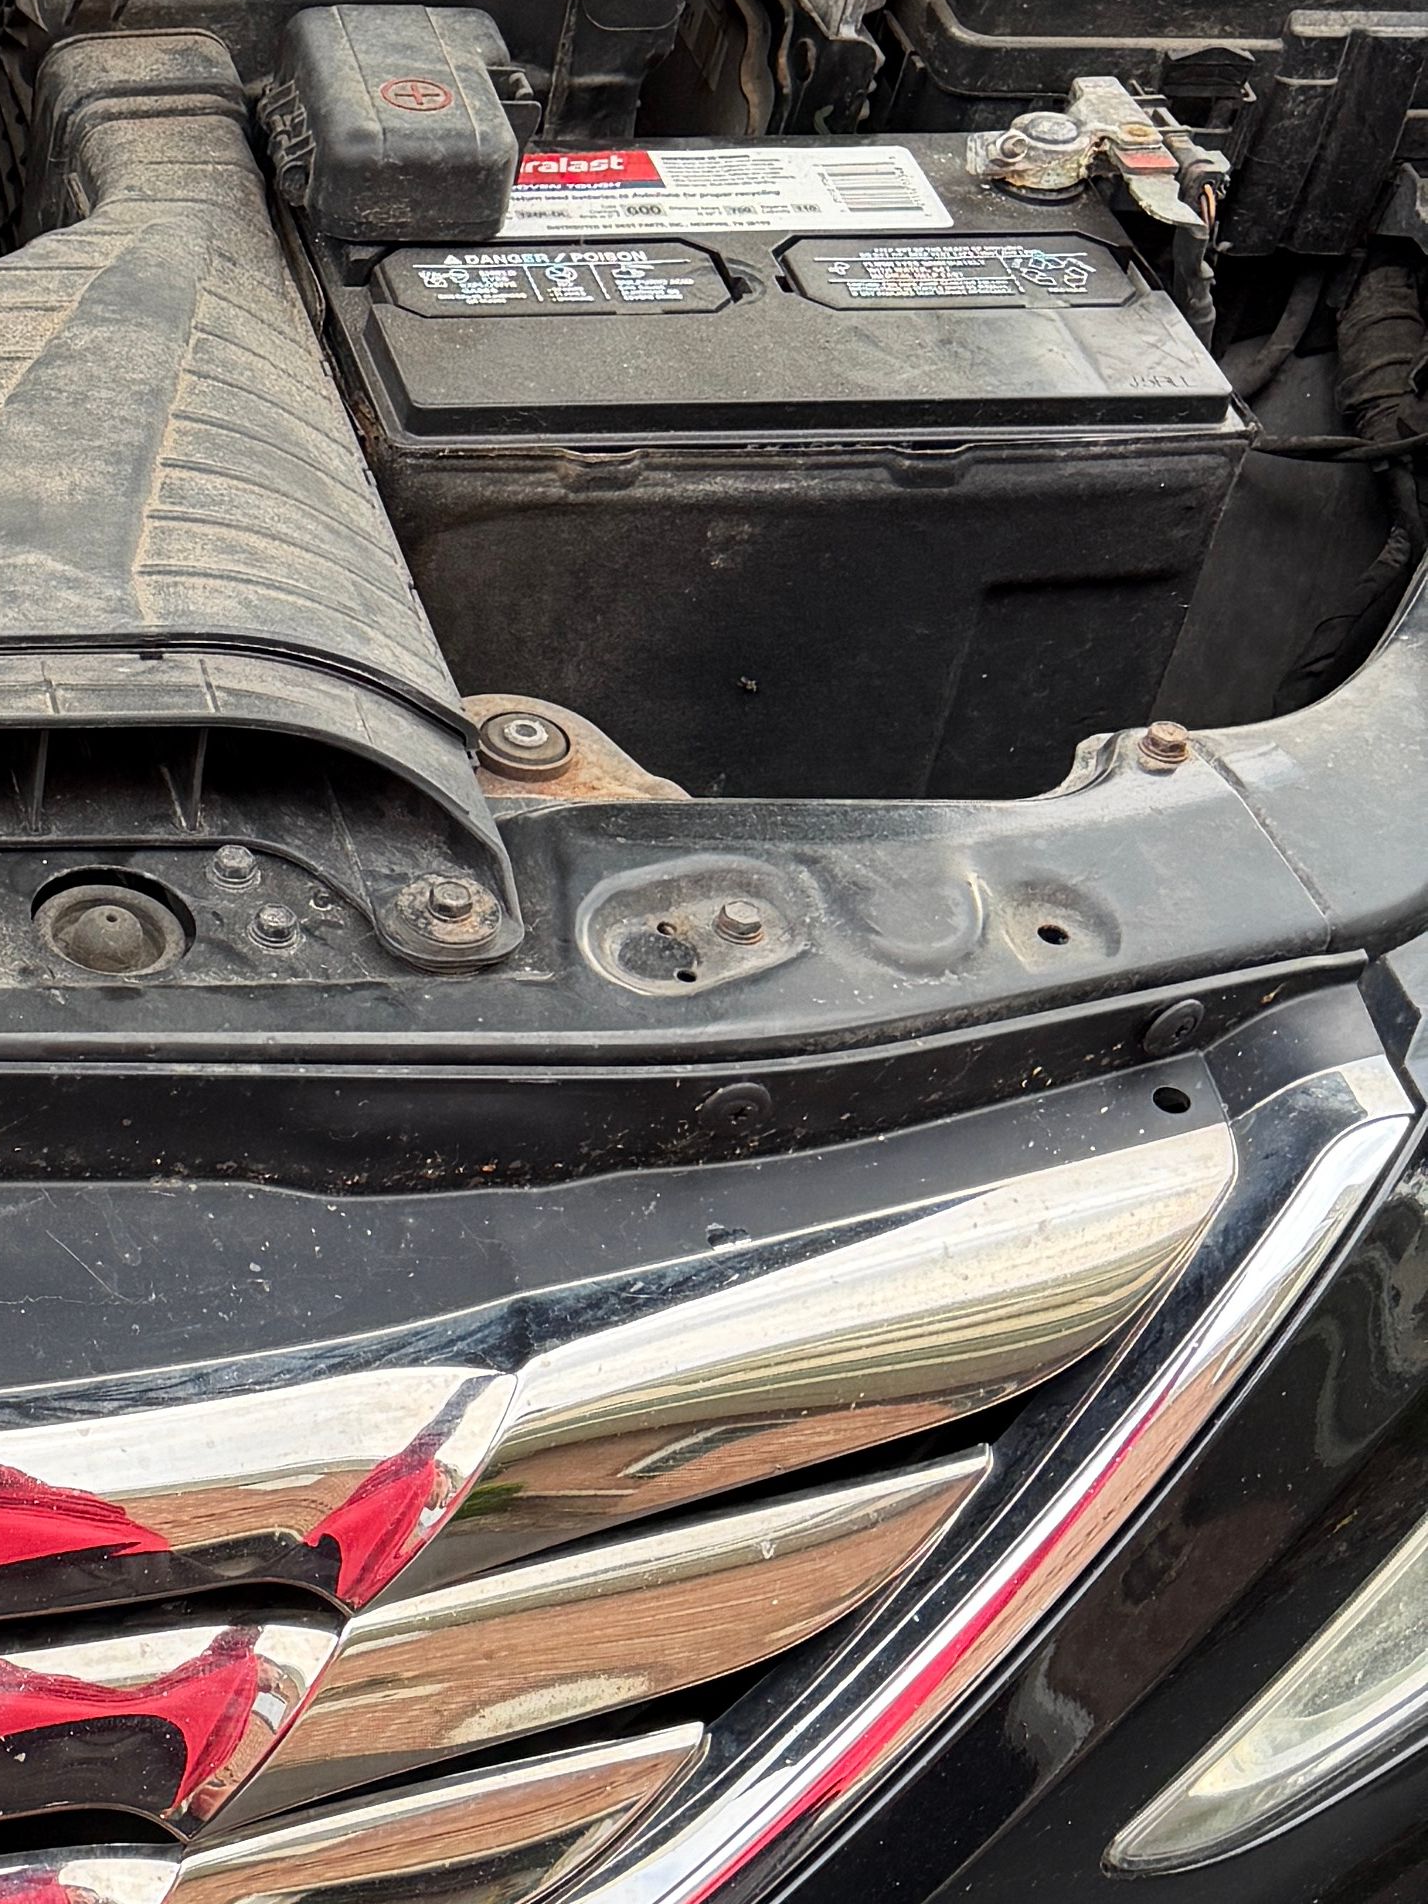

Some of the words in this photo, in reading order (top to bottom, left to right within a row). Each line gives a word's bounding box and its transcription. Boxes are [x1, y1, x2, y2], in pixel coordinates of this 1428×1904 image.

[520, 154, 625, 174] ralast
[567, 181, 622, 190] TOUGH
[626, 204, 662, 217] 600
[464, 253, 550, 265] DANGER
[570, 250, 648, 263] POISON
